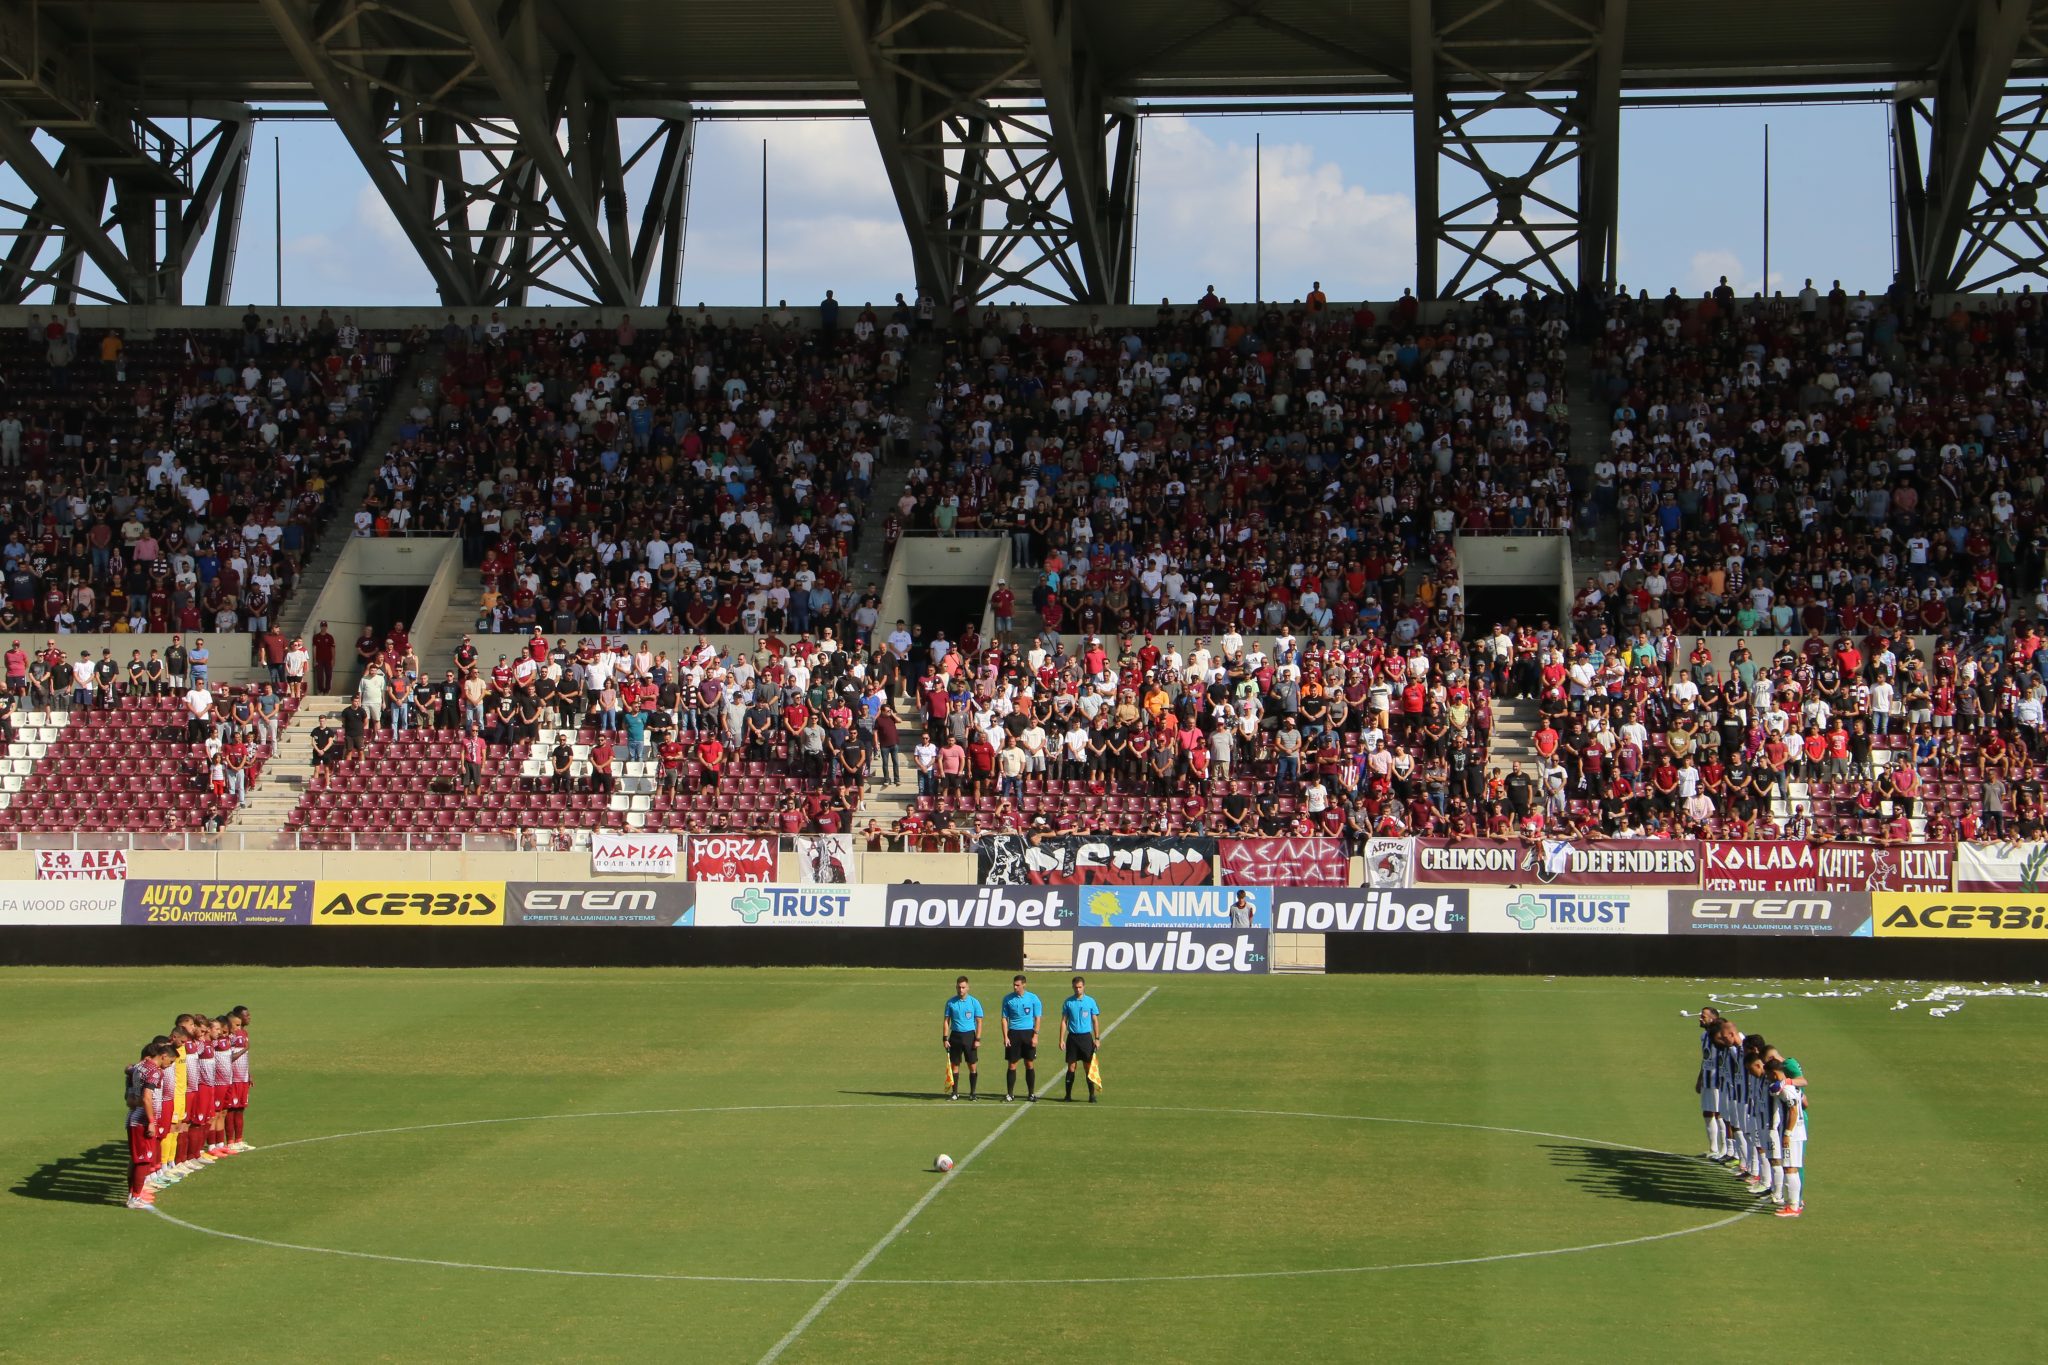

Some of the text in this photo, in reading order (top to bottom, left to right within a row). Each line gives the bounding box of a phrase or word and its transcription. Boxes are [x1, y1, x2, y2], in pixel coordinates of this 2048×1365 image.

[693, 838, 773, 866] FORZA
[1420, 847, 1696, 874] CRIMSON DEFENDERS
[1706, 842, 1814, 870] KOILADA
[1818, 848, 1949, 880] KATE RINI
[0, 899, 117, 911] FA WOOD GROUP
[141, 885, 297, 910] AUTO ΤΣΟΓΙΑΣ
[524, 890, 657, 910] ETEM
[764, 888, 850, 917] TRUST
[889, 888, 1074, 927] novibet 21+
[1277, 891, 1466, 931] novibet 21+
[1539, 894, 1630, 923] TRUST
[1692, 899, 1832, 919] ETEM
[148, 907, 182, 922] 250
[1076, 931, 1265, 972] novibet 21+
